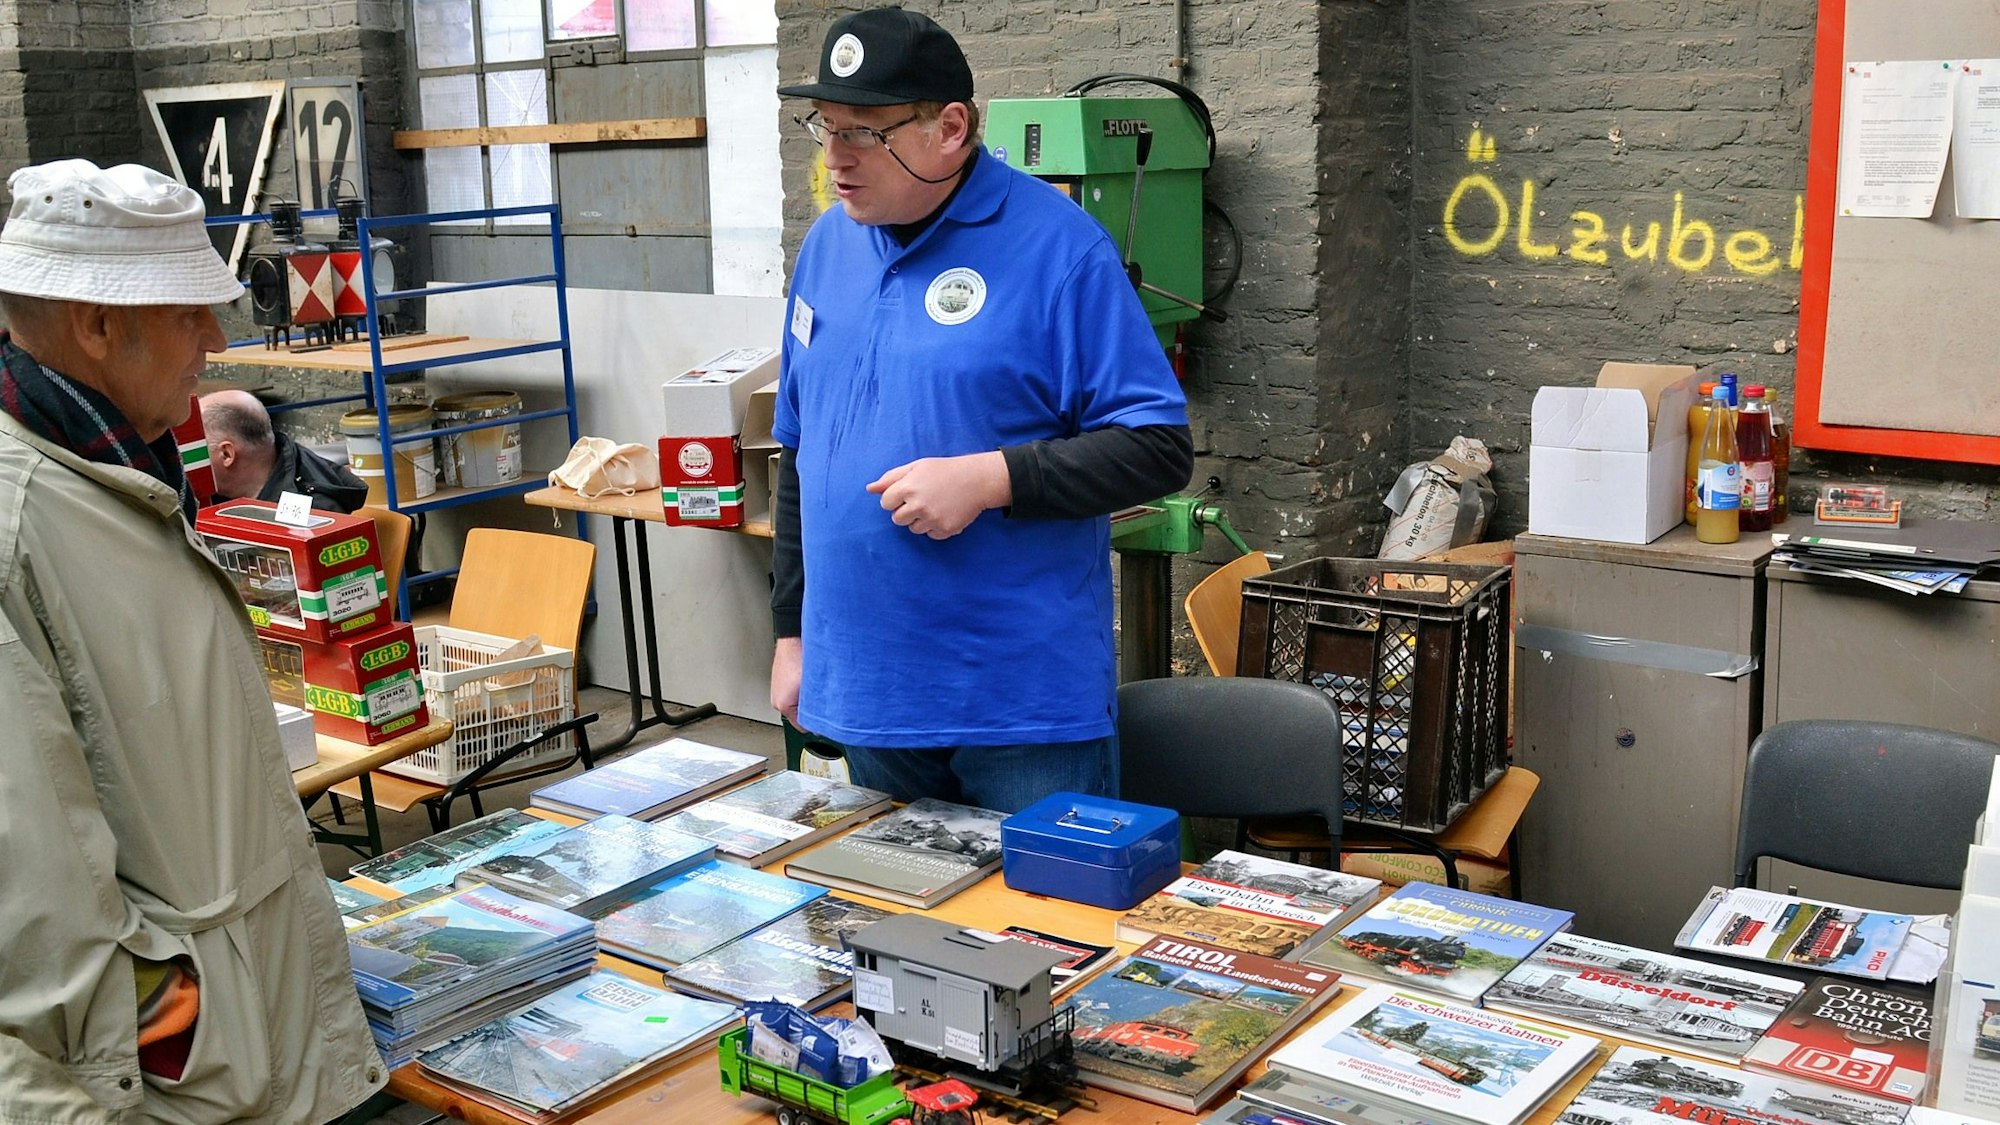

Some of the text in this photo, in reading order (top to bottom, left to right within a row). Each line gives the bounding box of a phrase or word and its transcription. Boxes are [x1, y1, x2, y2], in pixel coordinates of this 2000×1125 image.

[203, 117, 233, 204] 4
[300, 100, 350, 209] 12
[1412, 523, 1422, 535] 30
[1405, 535, 1417, 547] kg
[333, 606, 352, 617] 3020
[1368, 852, 1423, 872] COMFORT
[1186, 880, 1275, 905] Eisenbahn
[1450, 900, 1512, 917] CHRONIK
[1387, 901, 1545, 941] LOKOMOTIVEN
[1153, 940, 1238, 968] TIROL
[1592, 942, 1630, 954] Kandler
[1142, 950, 1316, 995] Bahnen und Landschaften
[1867, 950, 1887, 972] PIKO
[592, 988, 642, 1008] BAHN
[602, 982, 652, 1002] EISEN
[1576, 970, 1740, 1011] Düsseldorf
[1822, 984, 1932, 1018] Chron
[1871, 990, 1924, 1006] Erich Preuß
[921, 999, 931, 1008] AL
[1387, 996, 1564, 1047] Die Schweizer Bahnen
[1446, 1004, 1515, 1027] GEORG WAGNER
[1813, 1006, 1883, 1032] Bahn
[1837, 1021, 1904, 1041] 1994 bis heute
[1348, 1057, 1463, 1093] Eisenbahn und Landschaft
[1801, 1052, 1874, 1081] DB
[1361, 1073, 1425, 1097] Weltbild Verlag
[1363, 1067, 1462, 1100] Panorama-Aufnahmen
[1832, 1093, 1899, 1112] Markus Hehl
